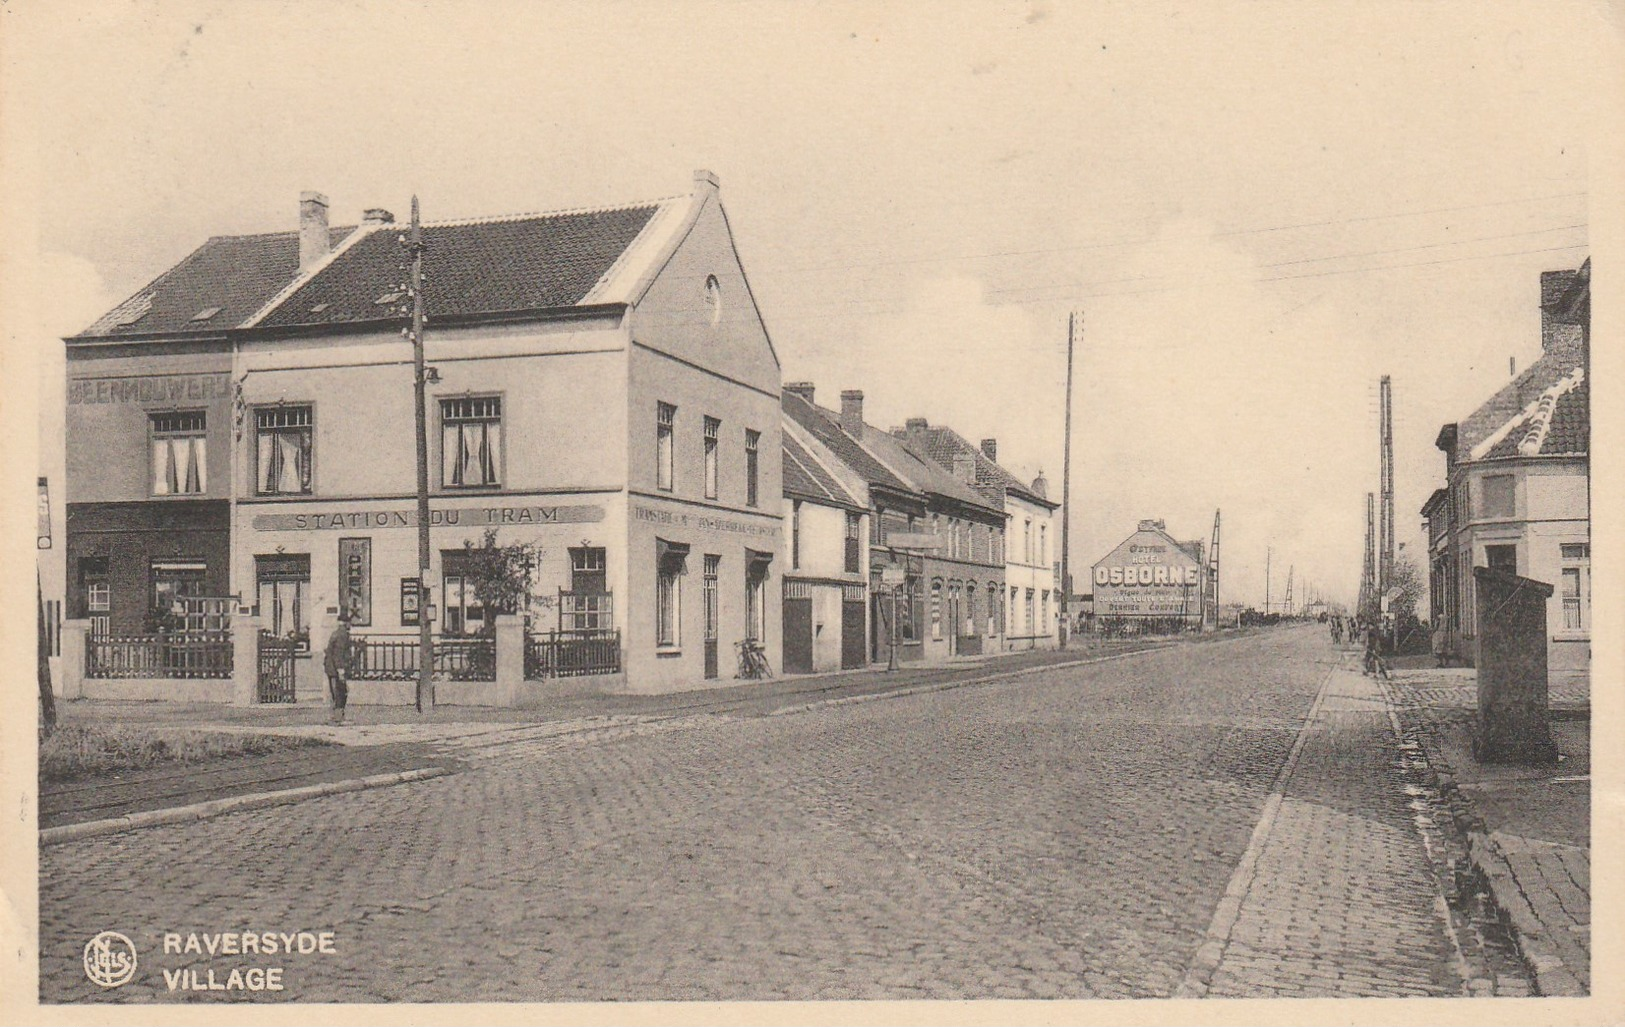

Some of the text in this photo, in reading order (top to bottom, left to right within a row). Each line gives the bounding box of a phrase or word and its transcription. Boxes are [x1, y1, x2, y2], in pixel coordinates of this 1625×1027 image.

[295, 507, 560, 529] STATION DU TRAM
[1131, 555, 1162, 565] HOTEL
[1095, 566, 1198, 587] OSBORNE
